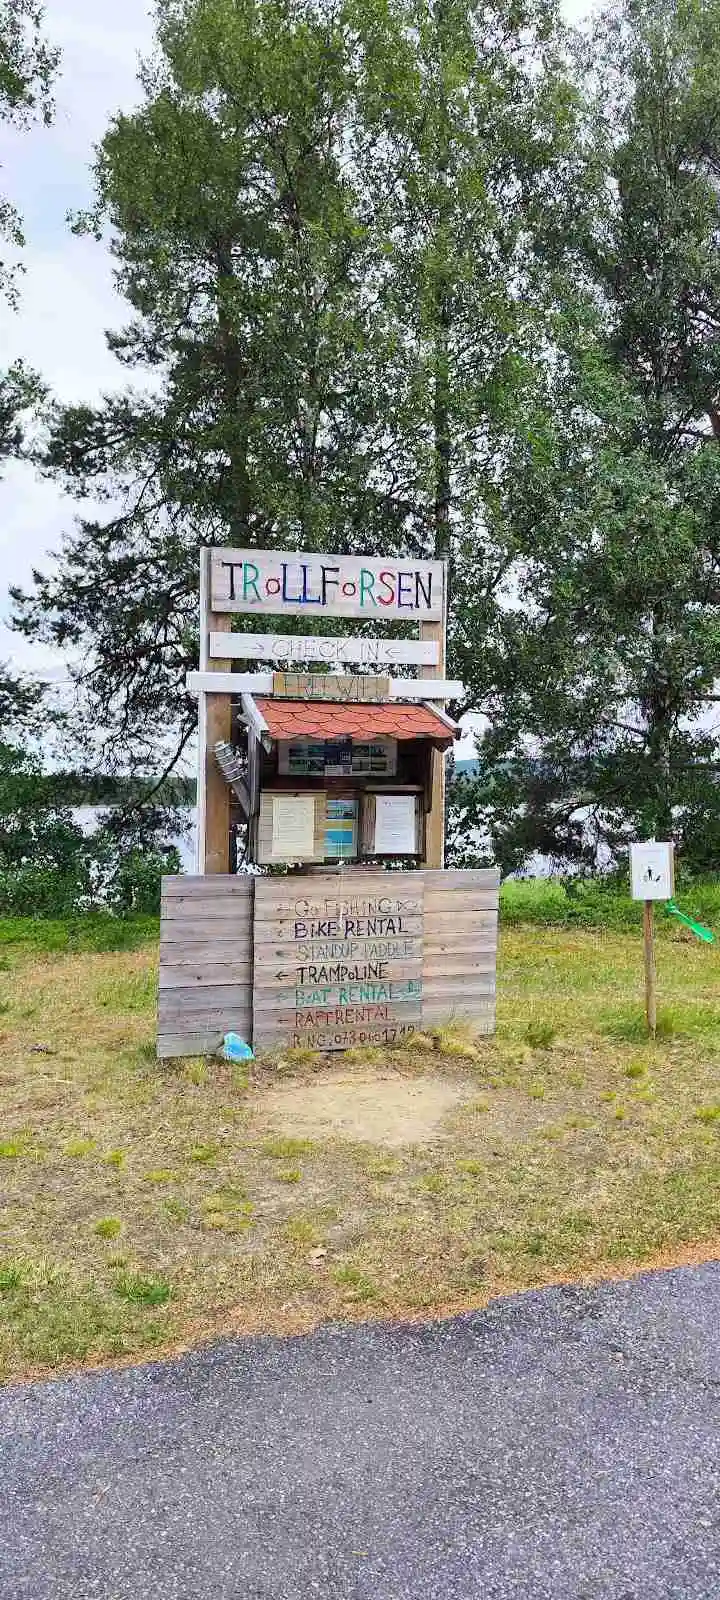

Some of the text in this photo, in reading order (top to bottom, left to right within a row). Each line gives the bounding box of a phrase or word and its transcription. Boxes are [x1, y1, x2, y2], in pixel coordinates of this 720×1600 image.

[272, 639, 381, 661] CHECK IN
[344, 917, 409, 940] RENTAL
[338, 982, 398, 1005] RENTAL
